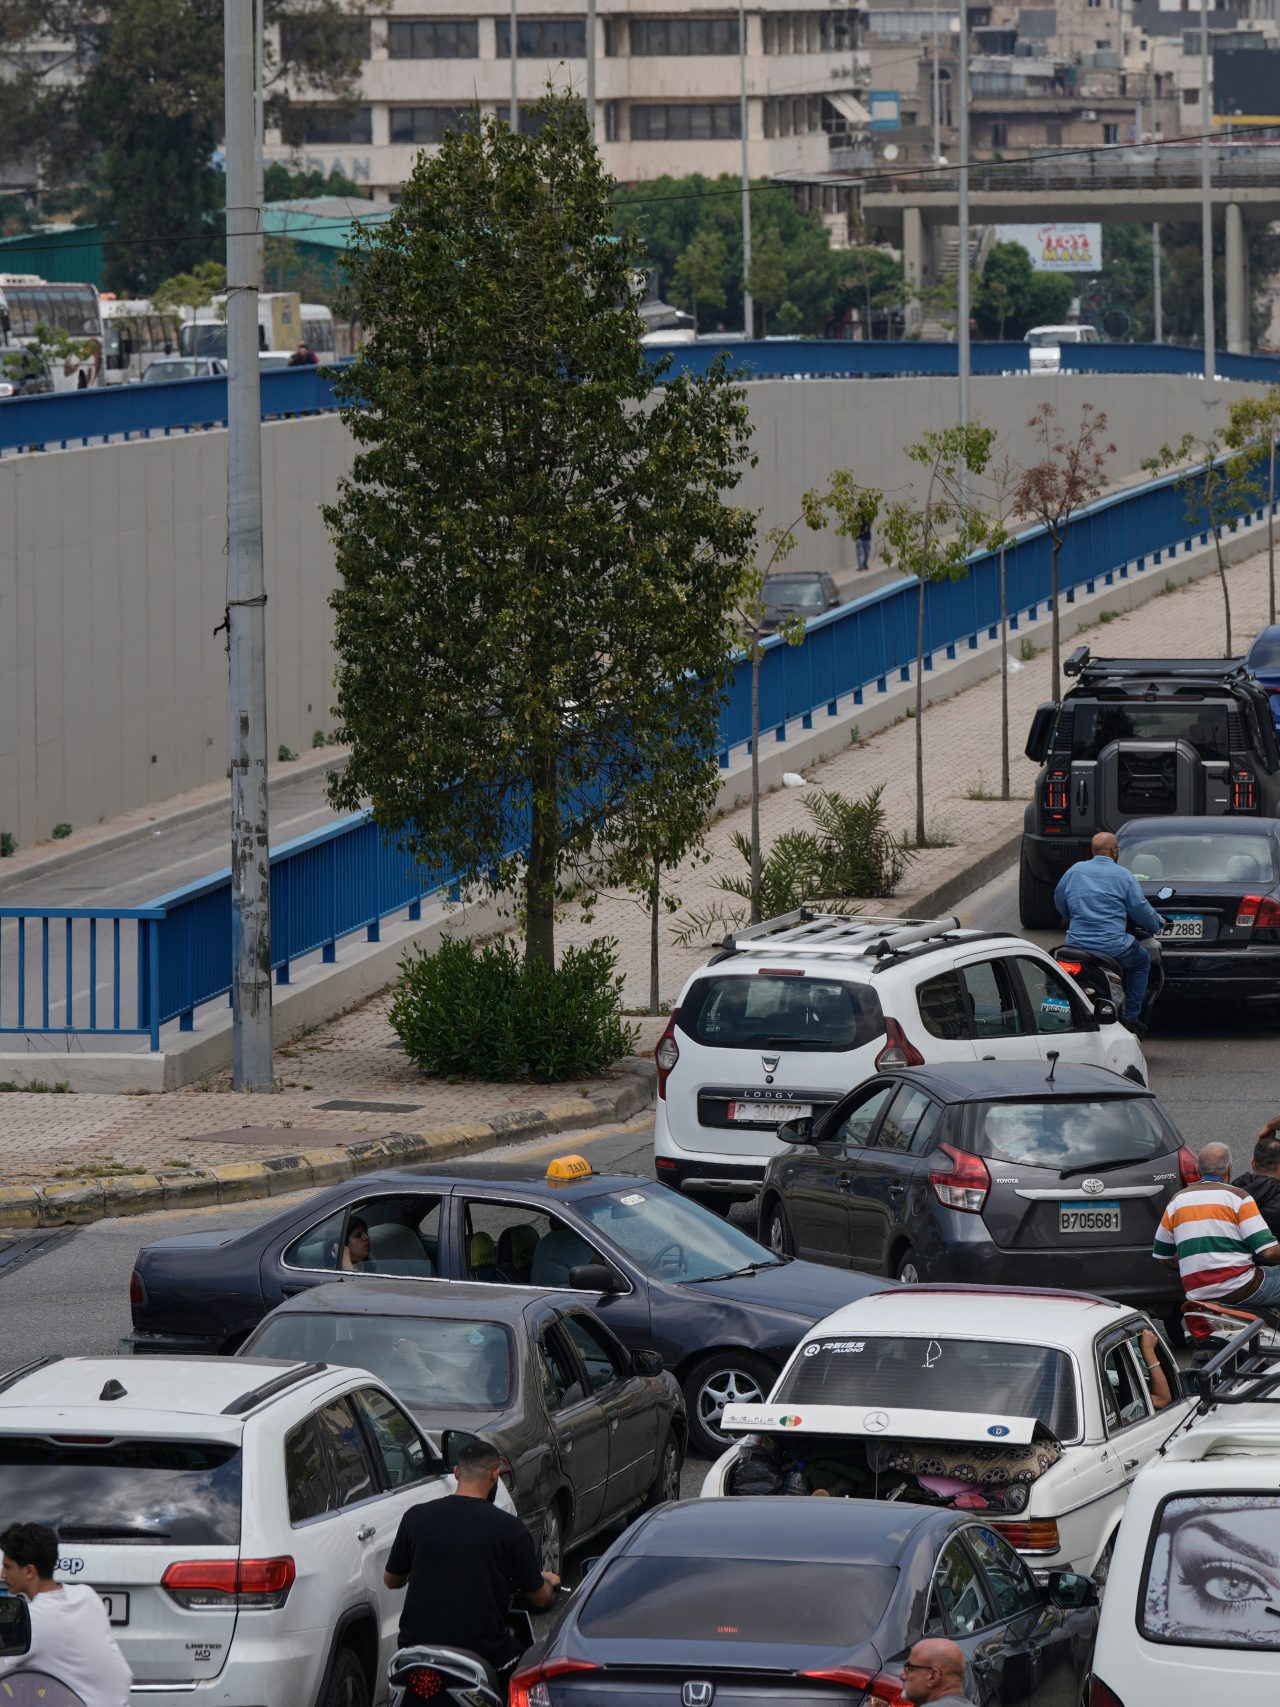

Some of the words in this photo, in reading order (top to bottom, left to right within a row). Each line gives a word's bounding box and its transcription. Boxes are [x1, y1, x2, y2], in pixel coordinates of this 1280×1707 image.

[744, 1090, 794, 1099] LODGY
[1061, 1213, 1119, 1229] B705681
[822, 1341, 866, 1350] REISS
[53, 1557, 84, 1574] eep
